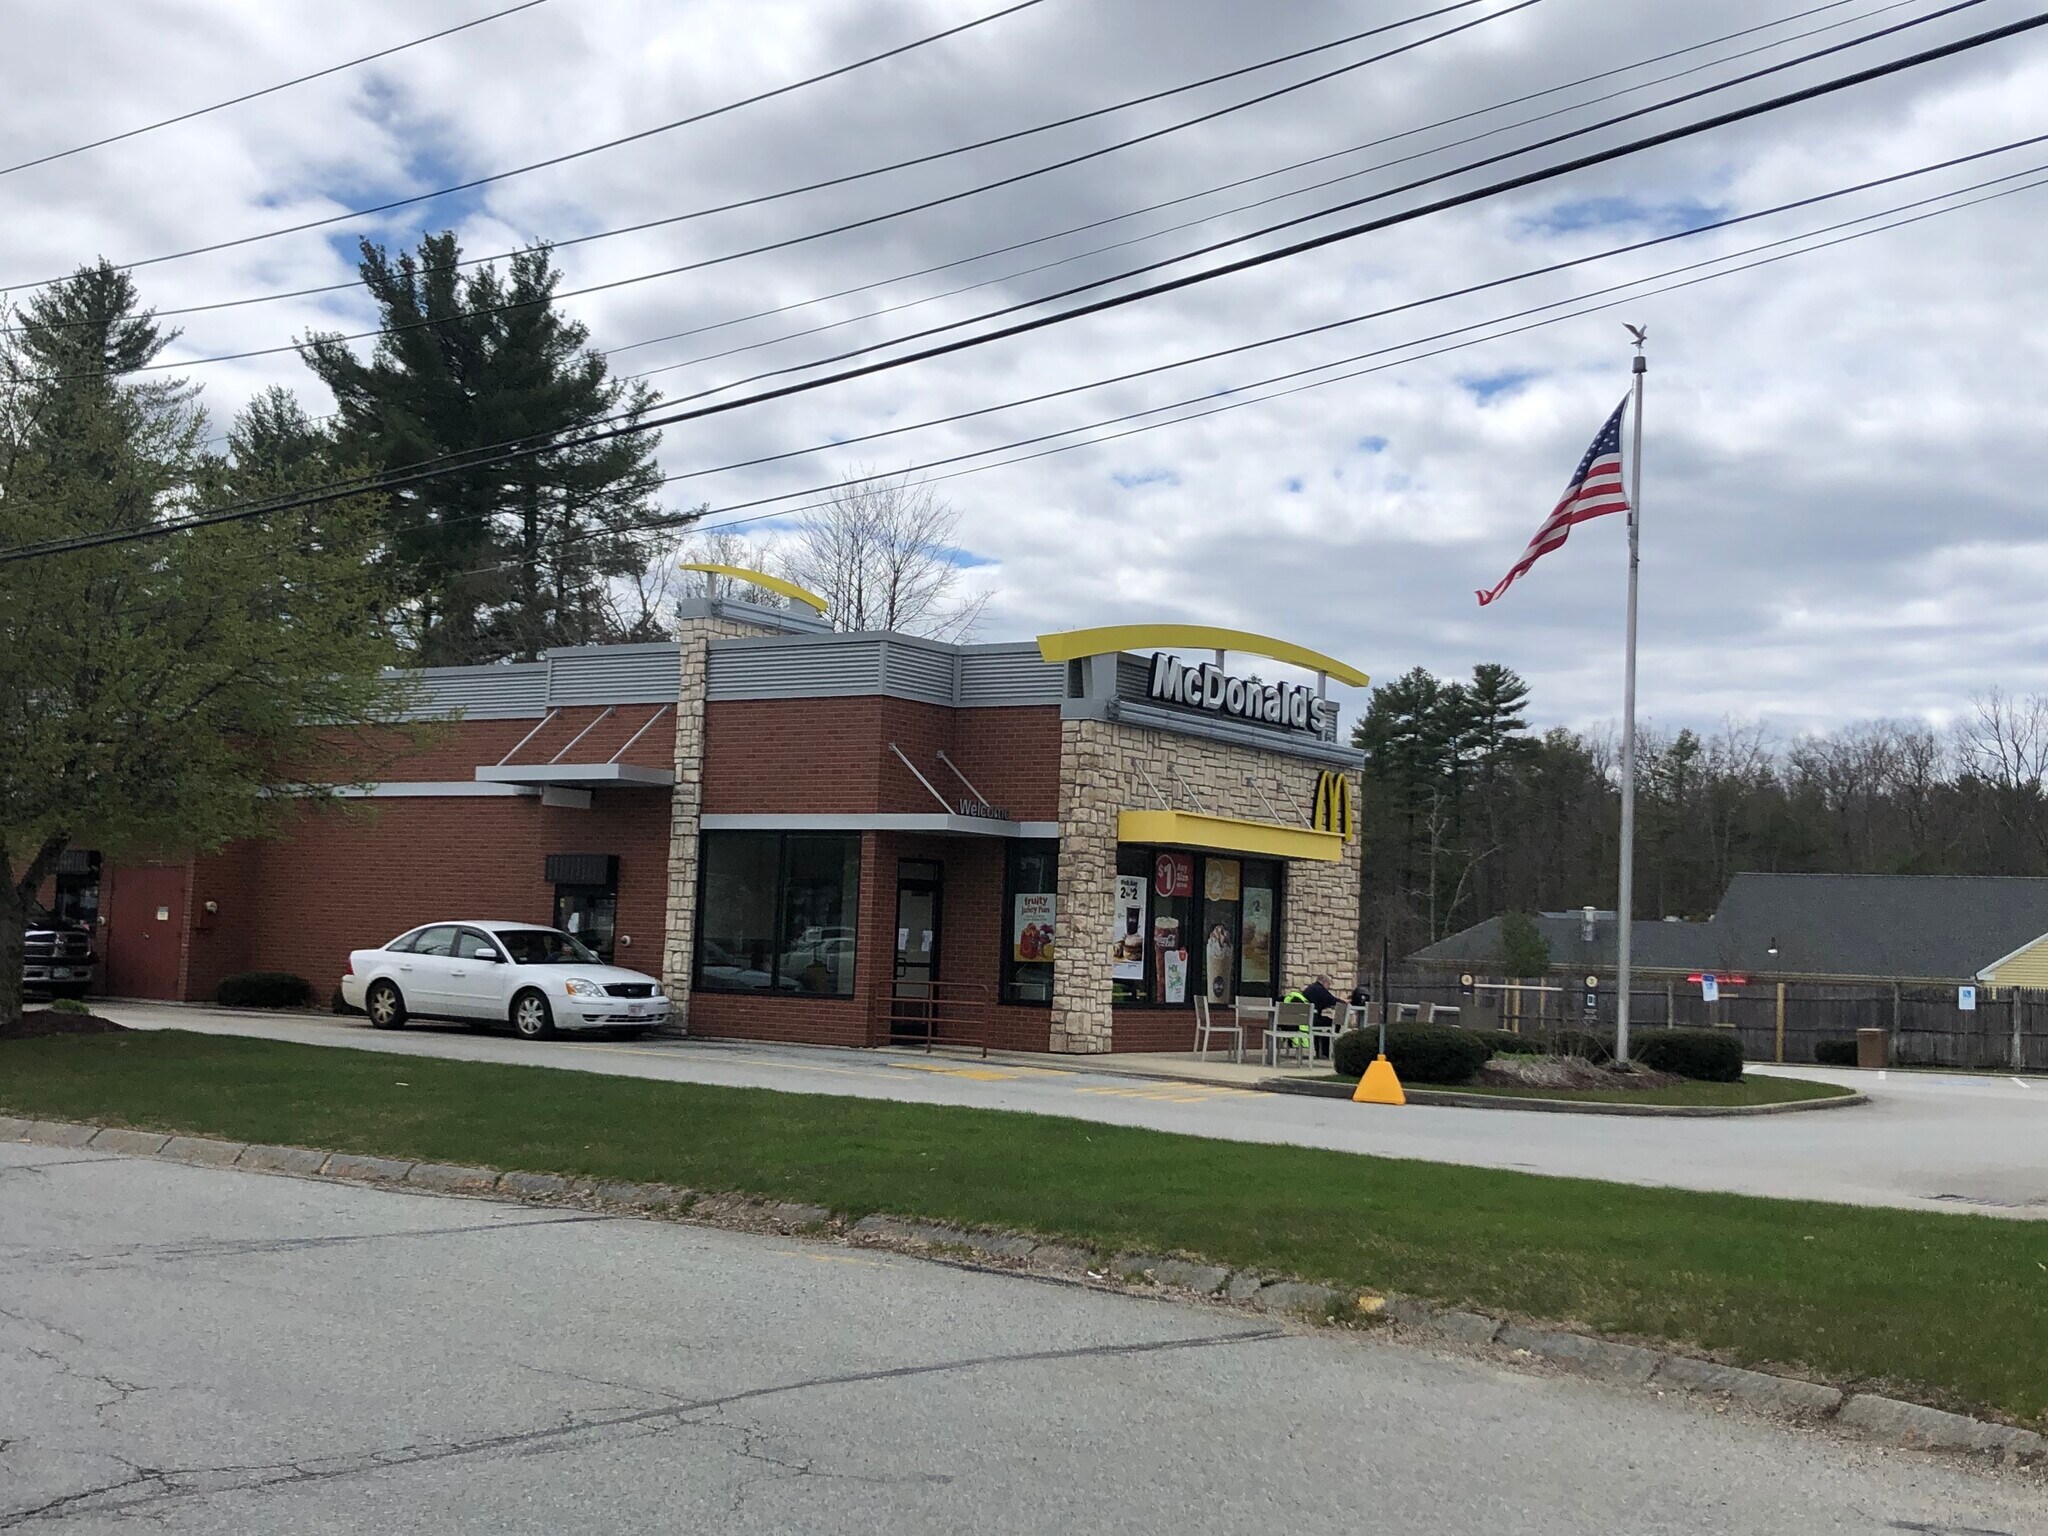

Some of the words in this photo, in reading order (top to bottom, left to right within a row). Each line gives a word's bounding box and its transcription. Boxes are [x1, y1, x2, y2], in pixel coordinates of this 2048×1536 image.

[1147, 652, 1327, 732] McDonald's
[959, 798, 1010, 820] Welcome
[1158, 863, 1172, 890] $1
[1024, 896, 1048, 906] fruity
[1120, 886, 1126, 899] 2
[1038, 906, 1050, 914] fun
